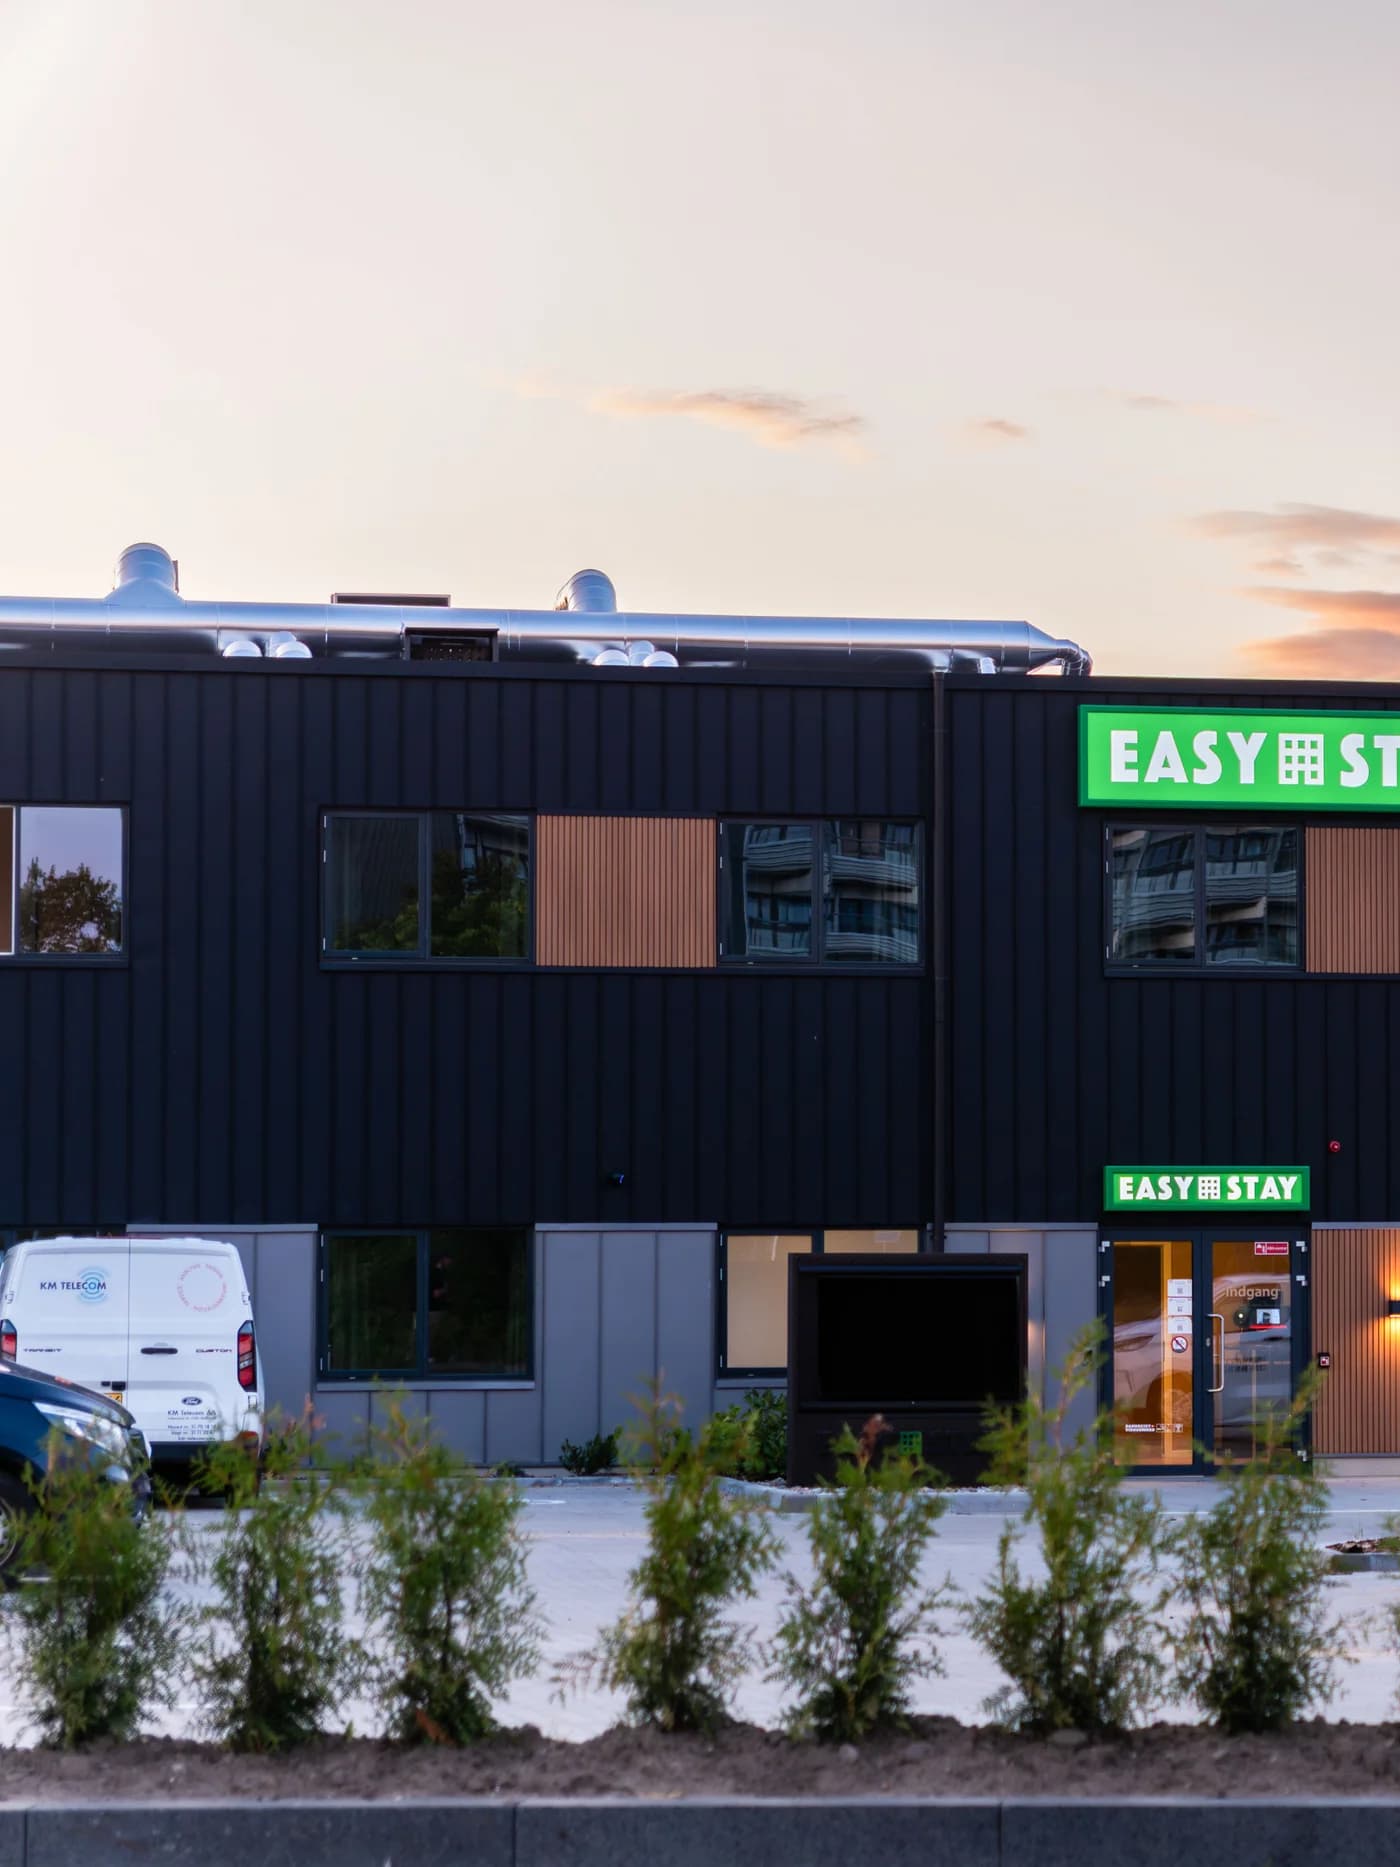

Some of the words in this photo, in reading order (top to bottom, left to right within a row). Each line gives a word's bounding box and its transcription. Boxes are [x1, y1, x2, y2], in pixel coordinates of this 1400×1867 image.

[1110, 730, 1267, 784] EASY
[1119, 1176, 1193, 1200] EASY
[1227, 1176, 1297, 1200] STAY
[40, 1282, 57, 1290] KM
[61, 1281, 106, 1290] TELECOM
